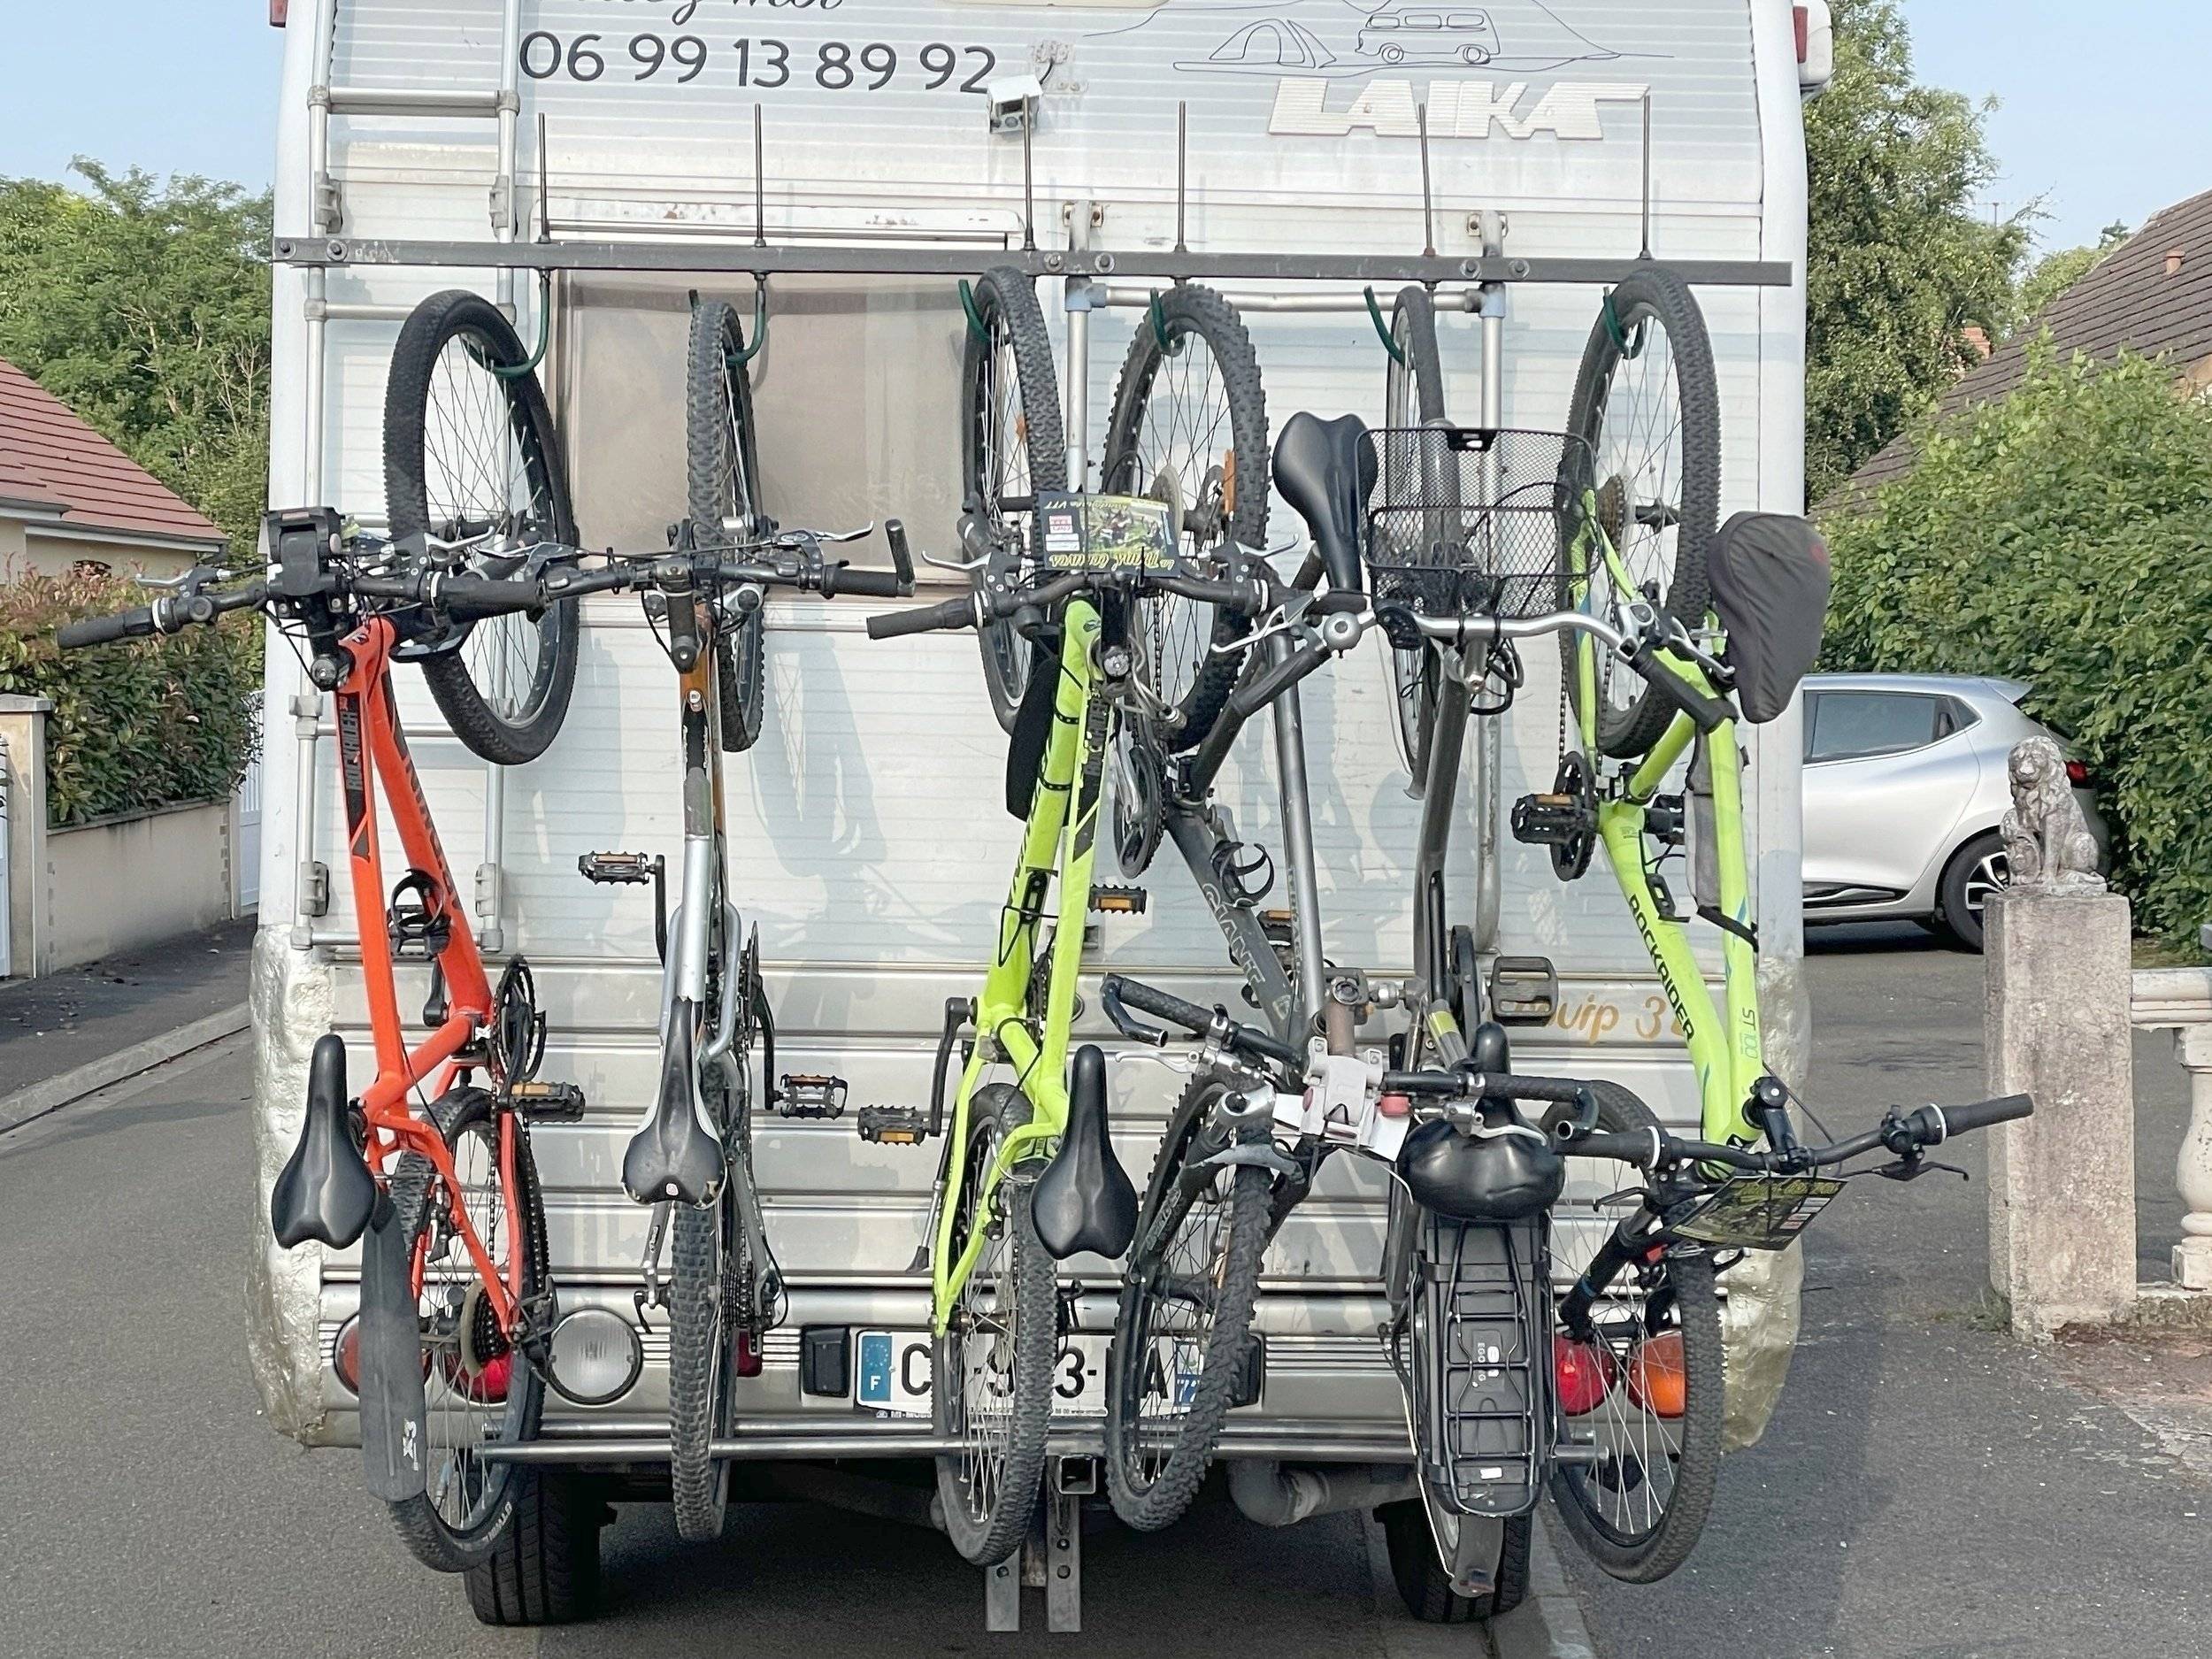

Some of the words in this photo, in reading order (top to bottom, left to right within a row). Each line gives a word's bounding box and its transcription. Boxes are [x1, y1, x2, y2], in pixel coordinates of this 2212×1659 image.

[518, 30, 605, 82] 06
[626, 33, 708, 84] 99
[733, 38, 790, 87] 13
[815, 41, 897, 91] 89
[918, 42, 996, 94] 92
[1267, 78, 1652, 141] LAIKA
[1628, 895, 1695, 1042] ROCKRIDER
[1741, 1007, 1756, 1031] ST
[1741, 1032, 1759, 1060] 100
[870, 1375, 881, 1391] F
